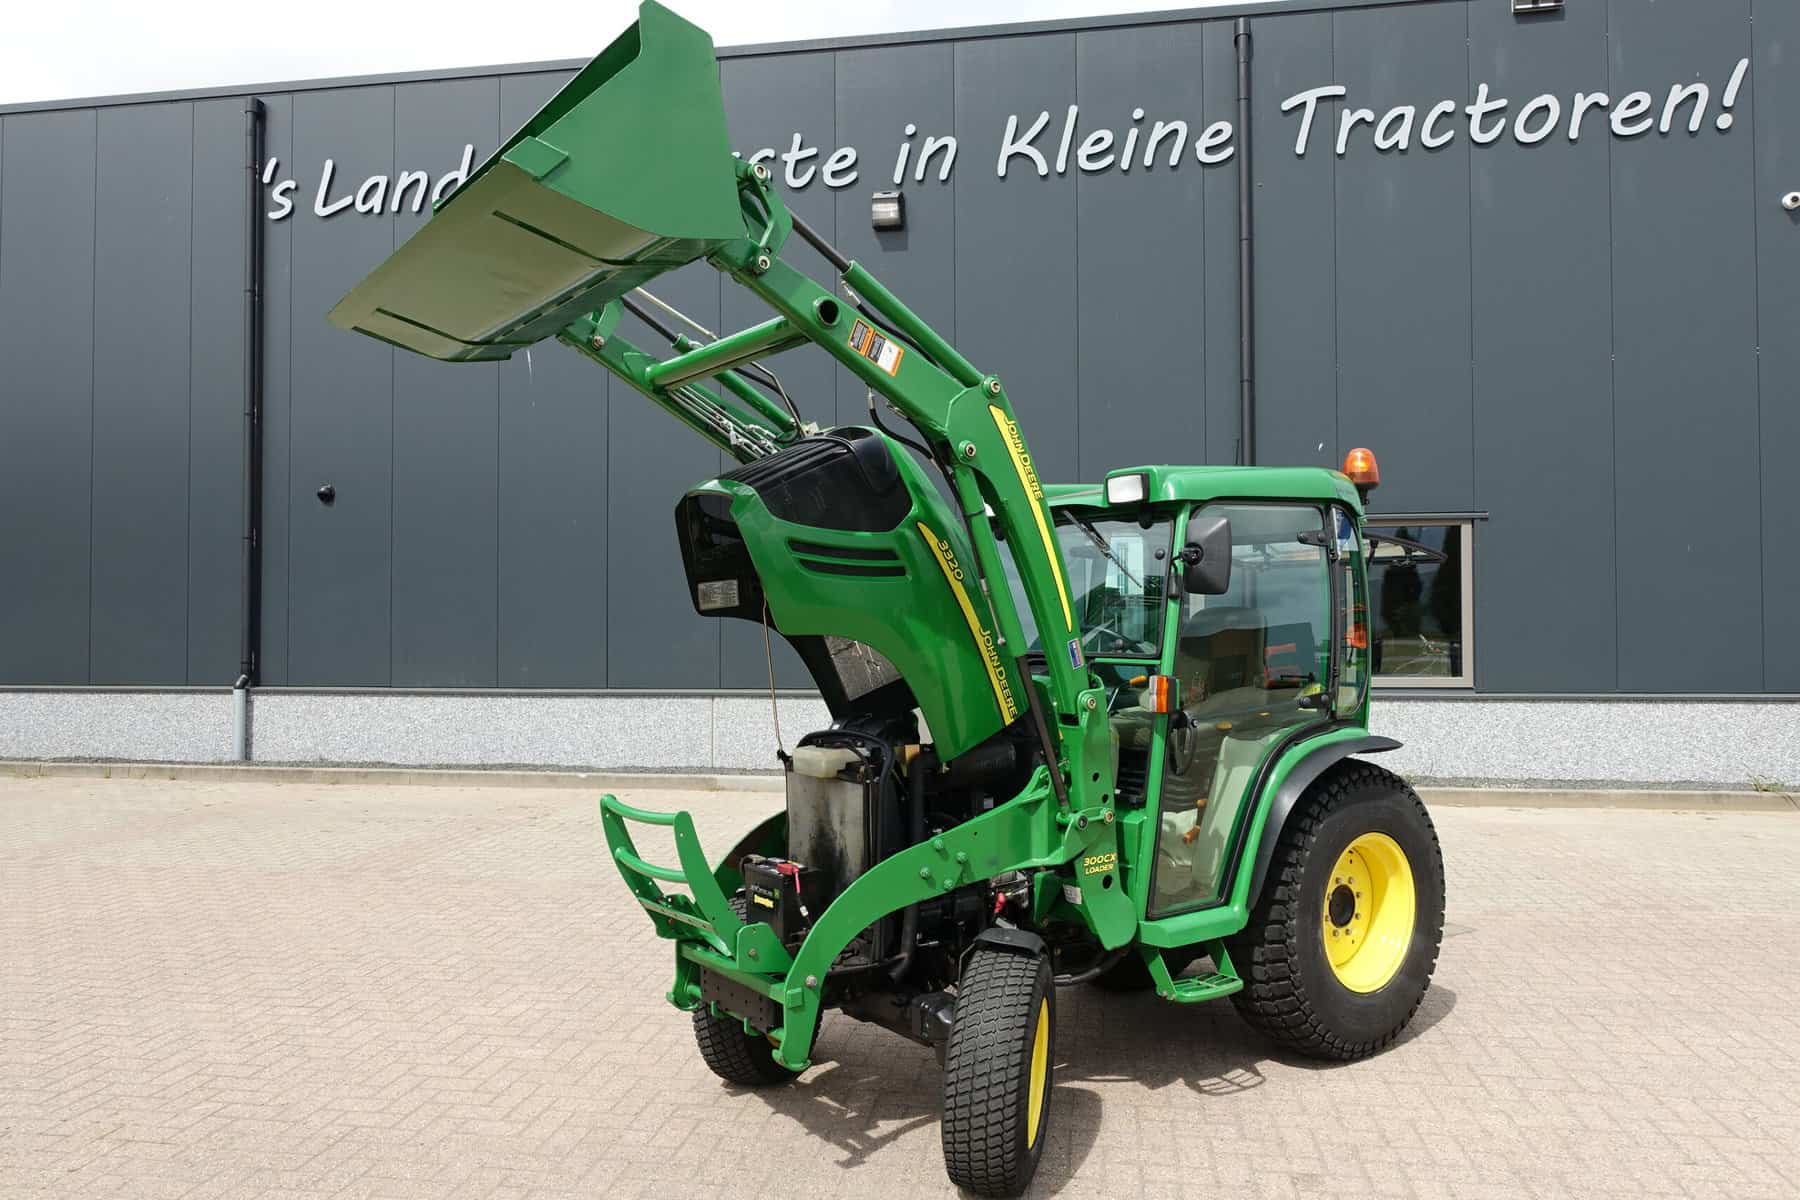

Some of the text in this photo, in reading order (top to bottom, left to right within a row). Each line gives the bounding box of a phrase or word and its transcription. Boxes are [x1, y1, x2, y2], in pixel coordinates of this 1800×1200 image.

[263, 157, 296, 220] 's
[314, 144, 473, 217] Land
[893, 123, 957, 184] in
[997, 104, 1235, 178] Kleine
[1281, 58, 1749, 155] Tractoren!
[1004, 416, 1044, 500] JOHN DEERE
[938, 540, 964, 581] 3320
[979, 626, 1017, 718] JOHN DEERE
[1083, 853, 1118, 866] 300CX
[1085, 863, 1114, 875] LOADER
